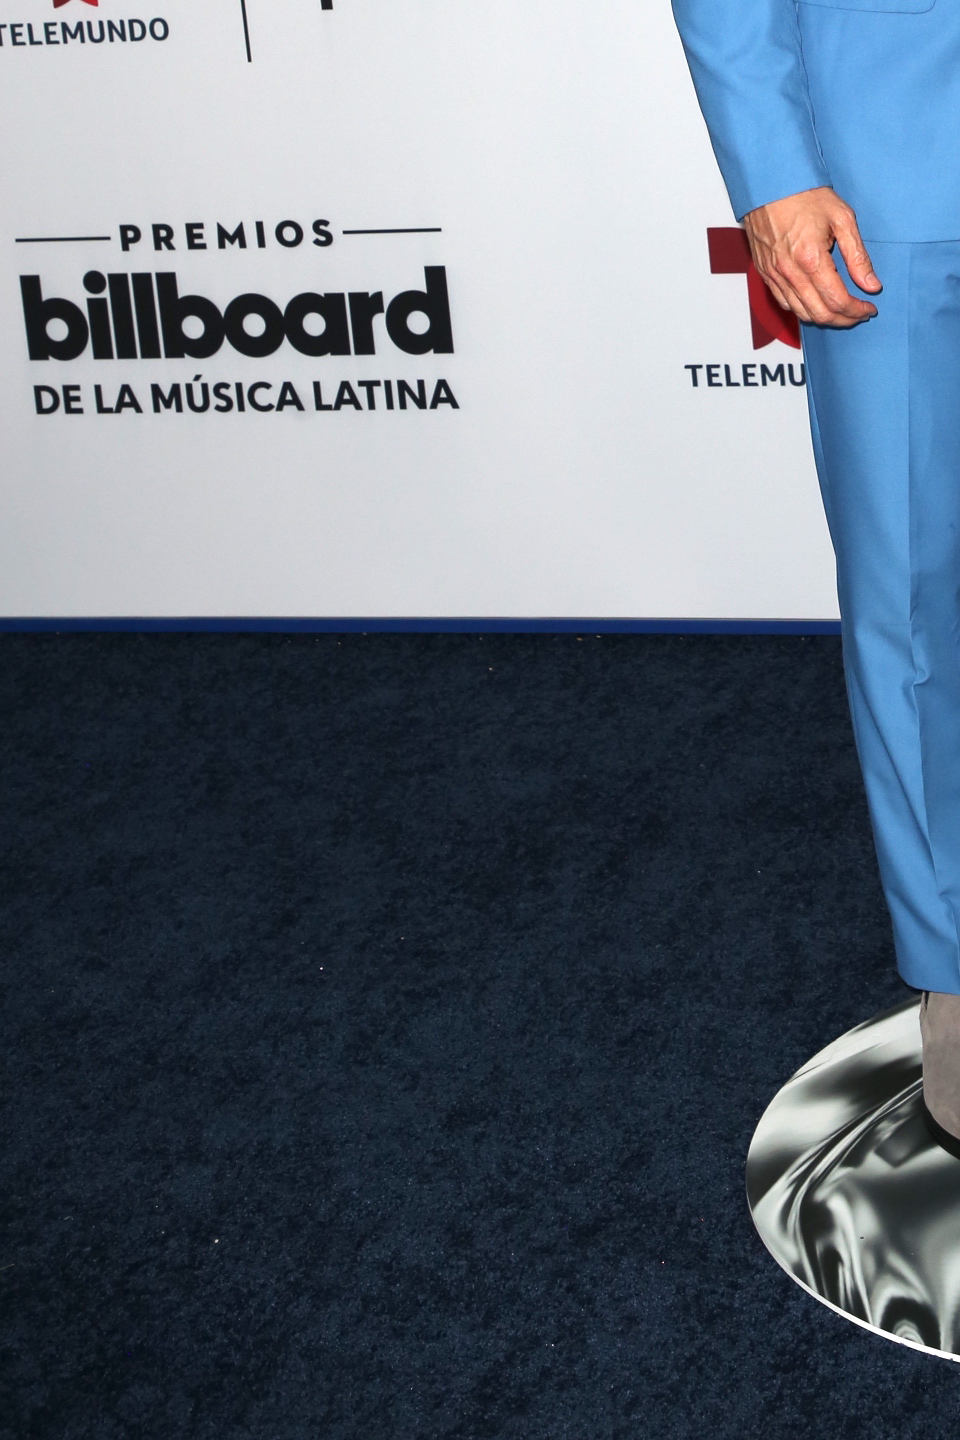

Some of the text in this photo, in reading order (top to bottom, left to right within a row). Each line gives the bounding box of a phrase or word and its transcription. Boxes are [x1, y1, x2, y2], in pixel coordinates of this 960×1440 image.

[119, 219, 334, 252] PREMIOS
[19, 265, 455, 362] billboard
[684, 363, 807, 387] TELEMU
[33, 374, 460, 415] DE LA MÚSICA LATINA
